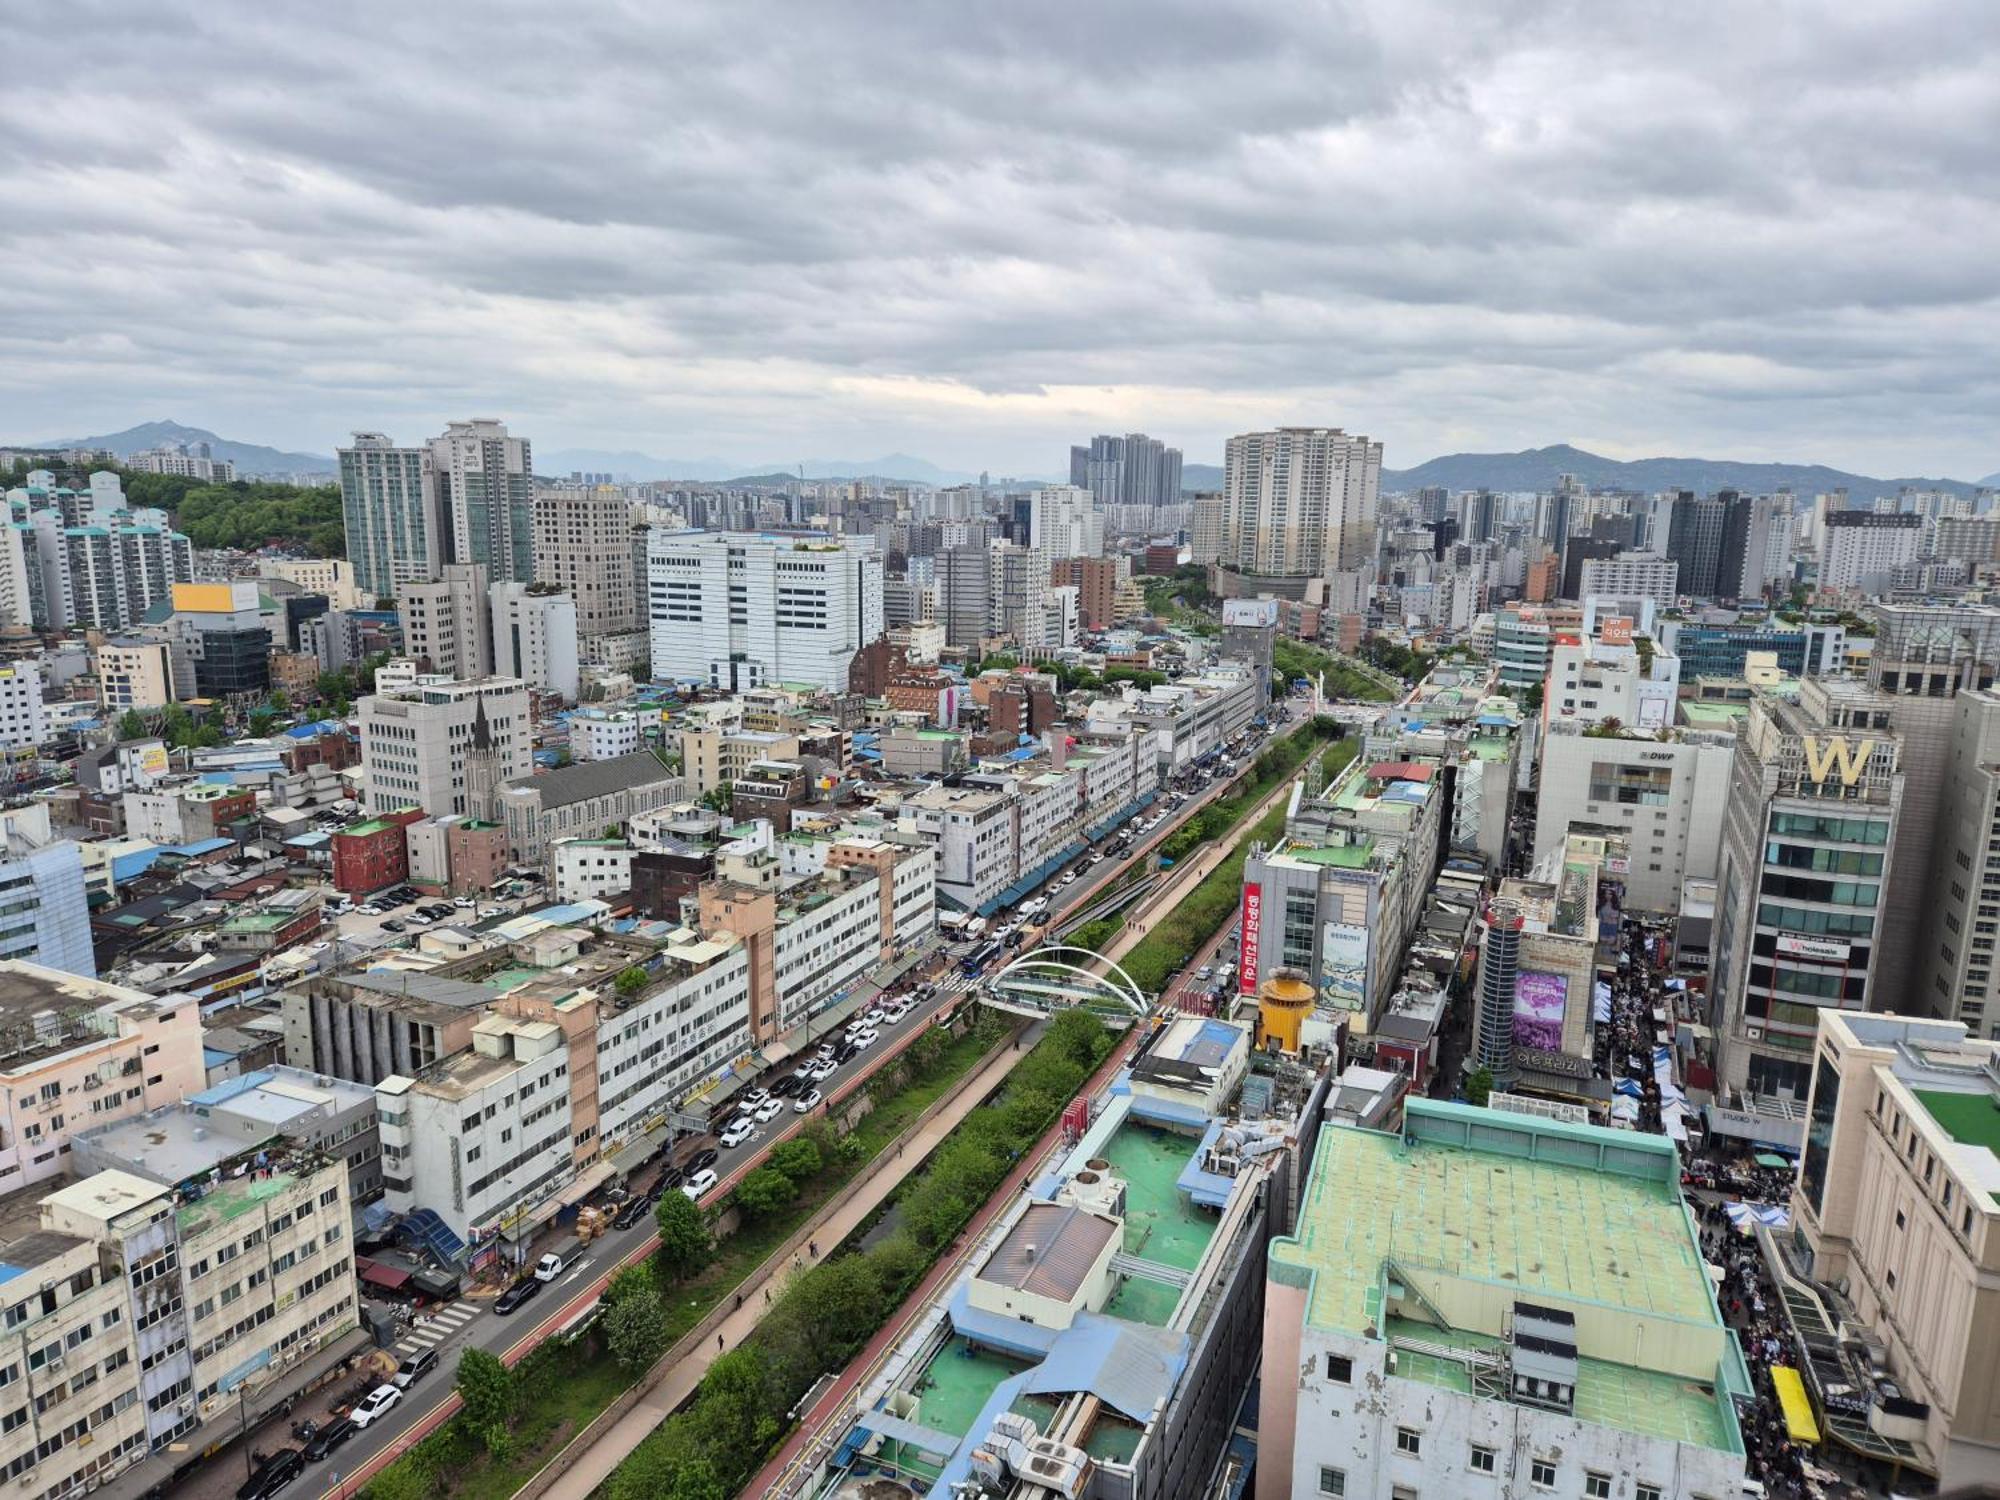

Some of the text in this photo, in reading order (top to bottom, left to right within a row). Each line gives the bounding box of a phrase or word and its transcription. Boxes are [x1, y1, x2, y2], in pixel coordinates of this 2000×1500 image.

[1650, 752, 1674, 761] DWP
[1804, 735, 1874, 785] W
[1244, 895, 1260, 980] 동평화패션타운
[1789, 940, 1838, 955] Wholesale
[1518, 1053, 1577, 1072] 아트프라자
